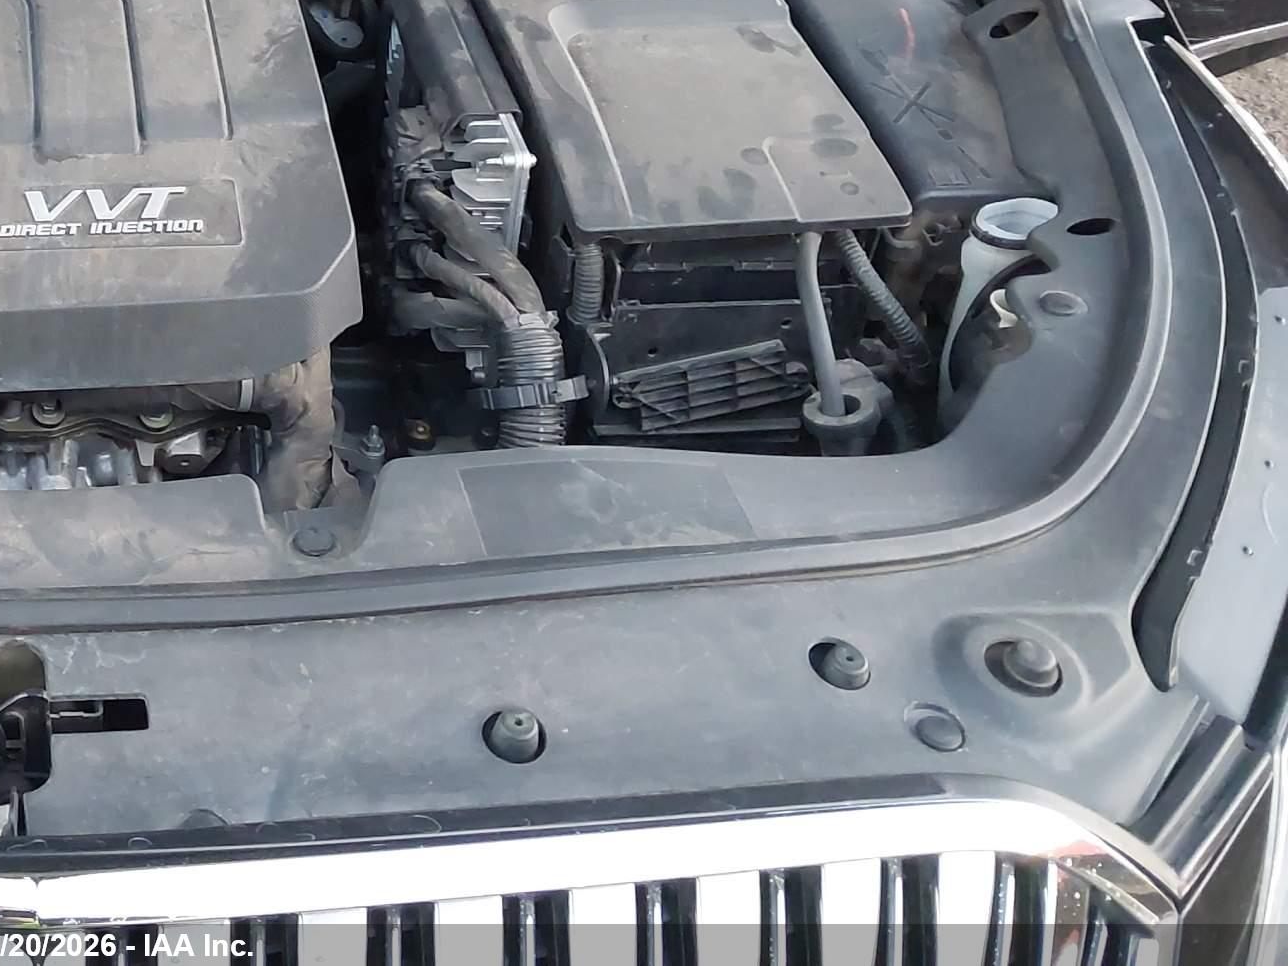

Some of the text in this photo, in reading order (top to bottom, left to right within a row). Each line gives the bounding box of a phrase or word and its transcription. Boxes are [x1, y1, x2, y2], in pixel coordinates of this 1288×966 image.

[24, 186, 187, 222] VVT
[0, 218, 205, 238] DIRECT INJECTION
